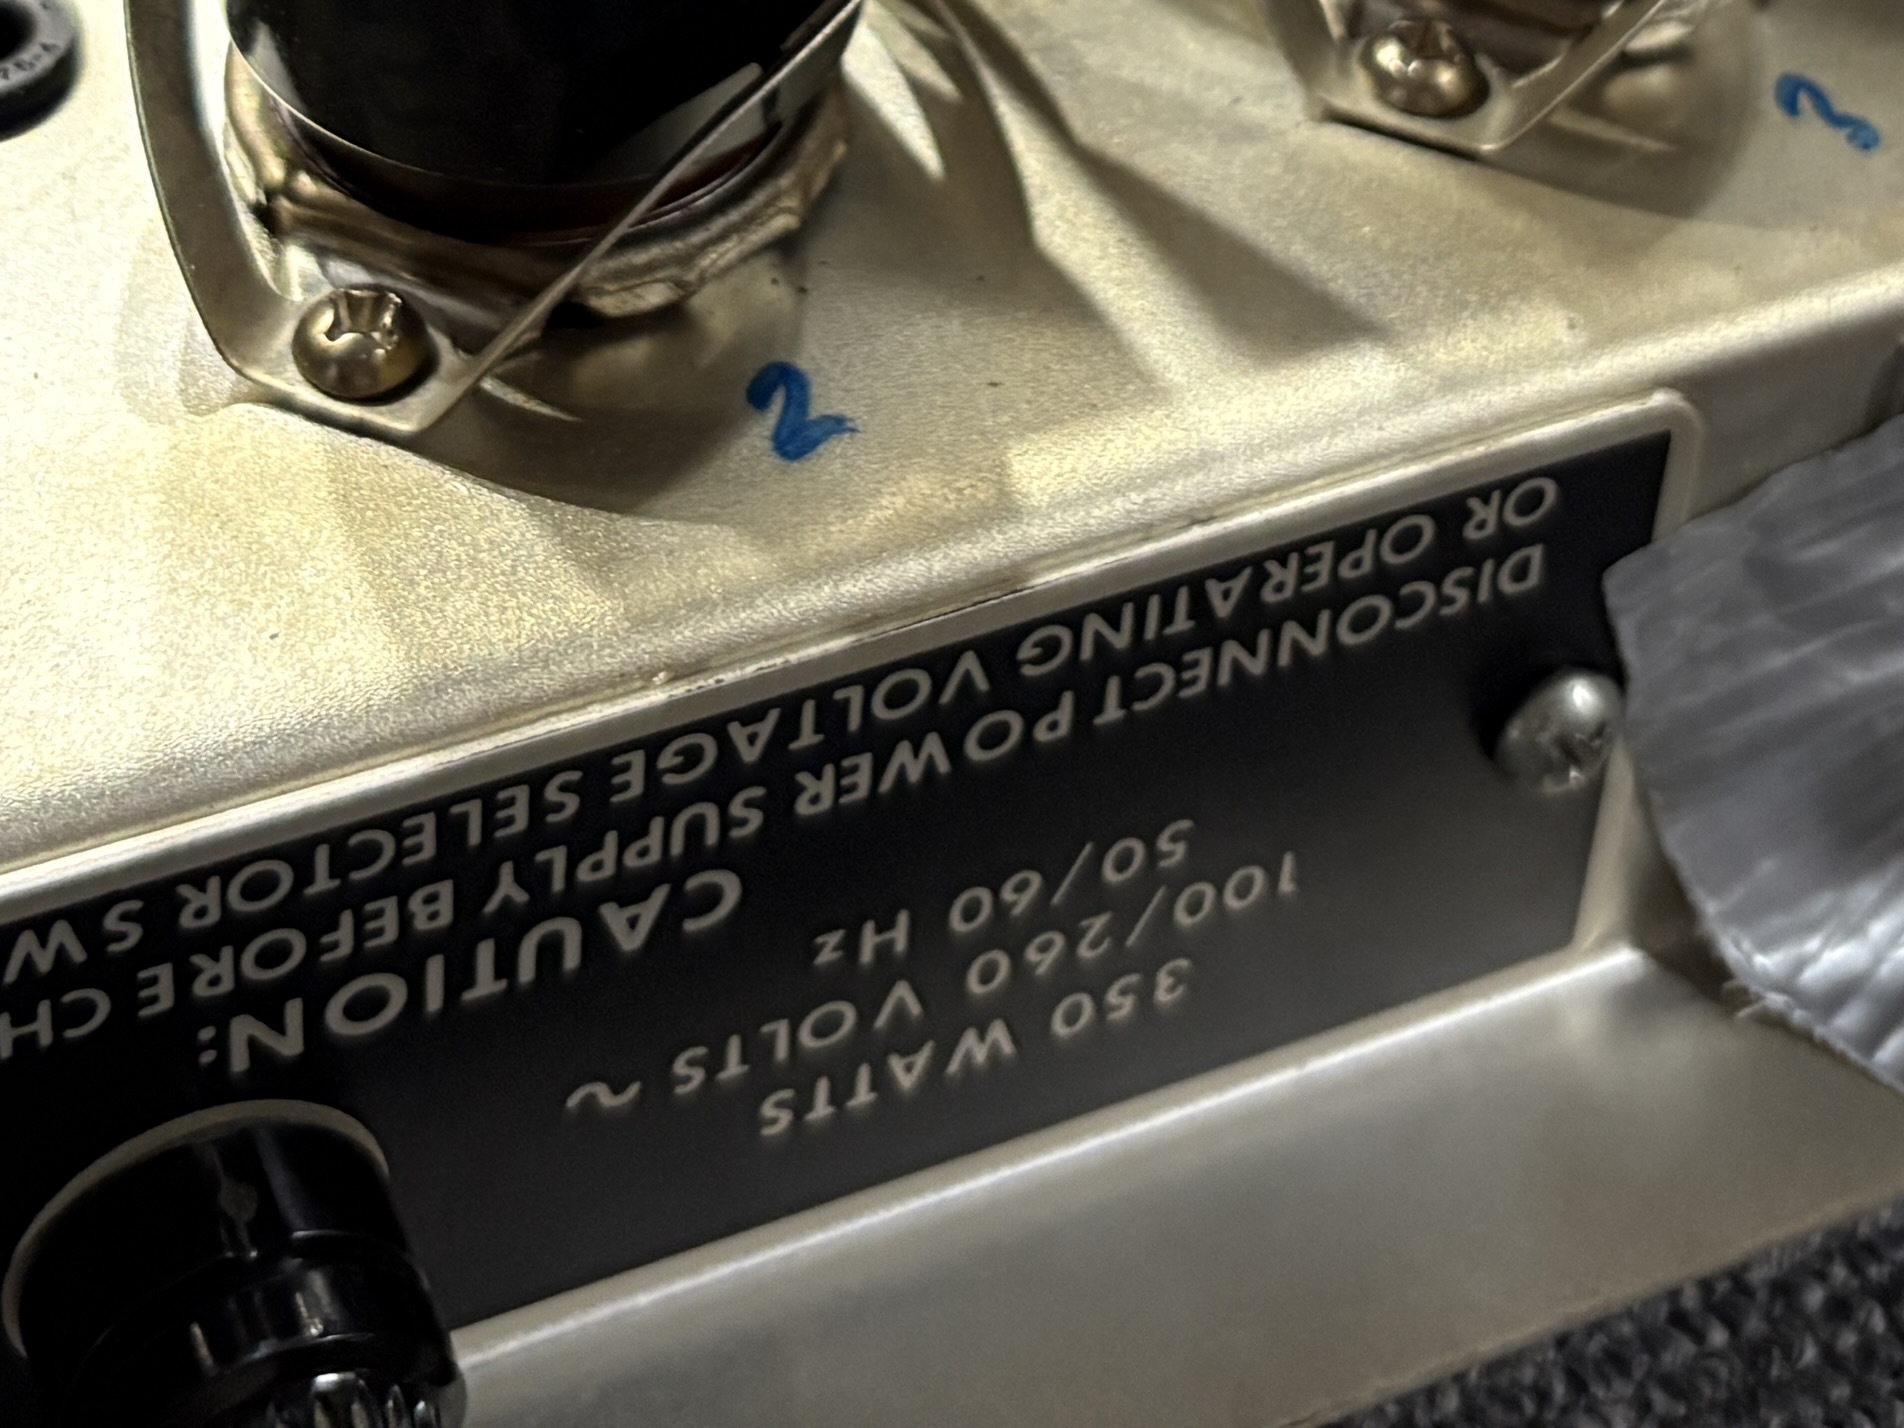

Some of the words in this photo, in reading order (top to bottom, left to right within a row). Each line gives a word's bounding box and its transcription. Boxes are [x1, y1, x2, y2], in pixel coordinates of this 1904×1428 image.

[745, 360, 860, 463] 2
[1463, 476, 1557, 539] OR
[1017, 514, 1435, 677] OPERATING
[1094, 544, 1544, 725] DISCONNECT
[610, 650, 990, 802] VOLTAGE
[796, 690, 1074, 816] POWER
[178, 771, 582, 929] SELECTOR
[482, 787, 767, 916] SUPPLY
[949, 819, 1194, 934] 50/60
[138, 880, 455, 1018] BEFORE
[199, 869, 743, 1072] CAUTION:
[813, 910, 909, 965] Hz
[966, 852, 1298, 994] 100/260
[673, 980, 922, 1094] VOLTS
[1052, 958, 1190, 1038] 350
[759, 1018, 1017, 1136] WATTS
